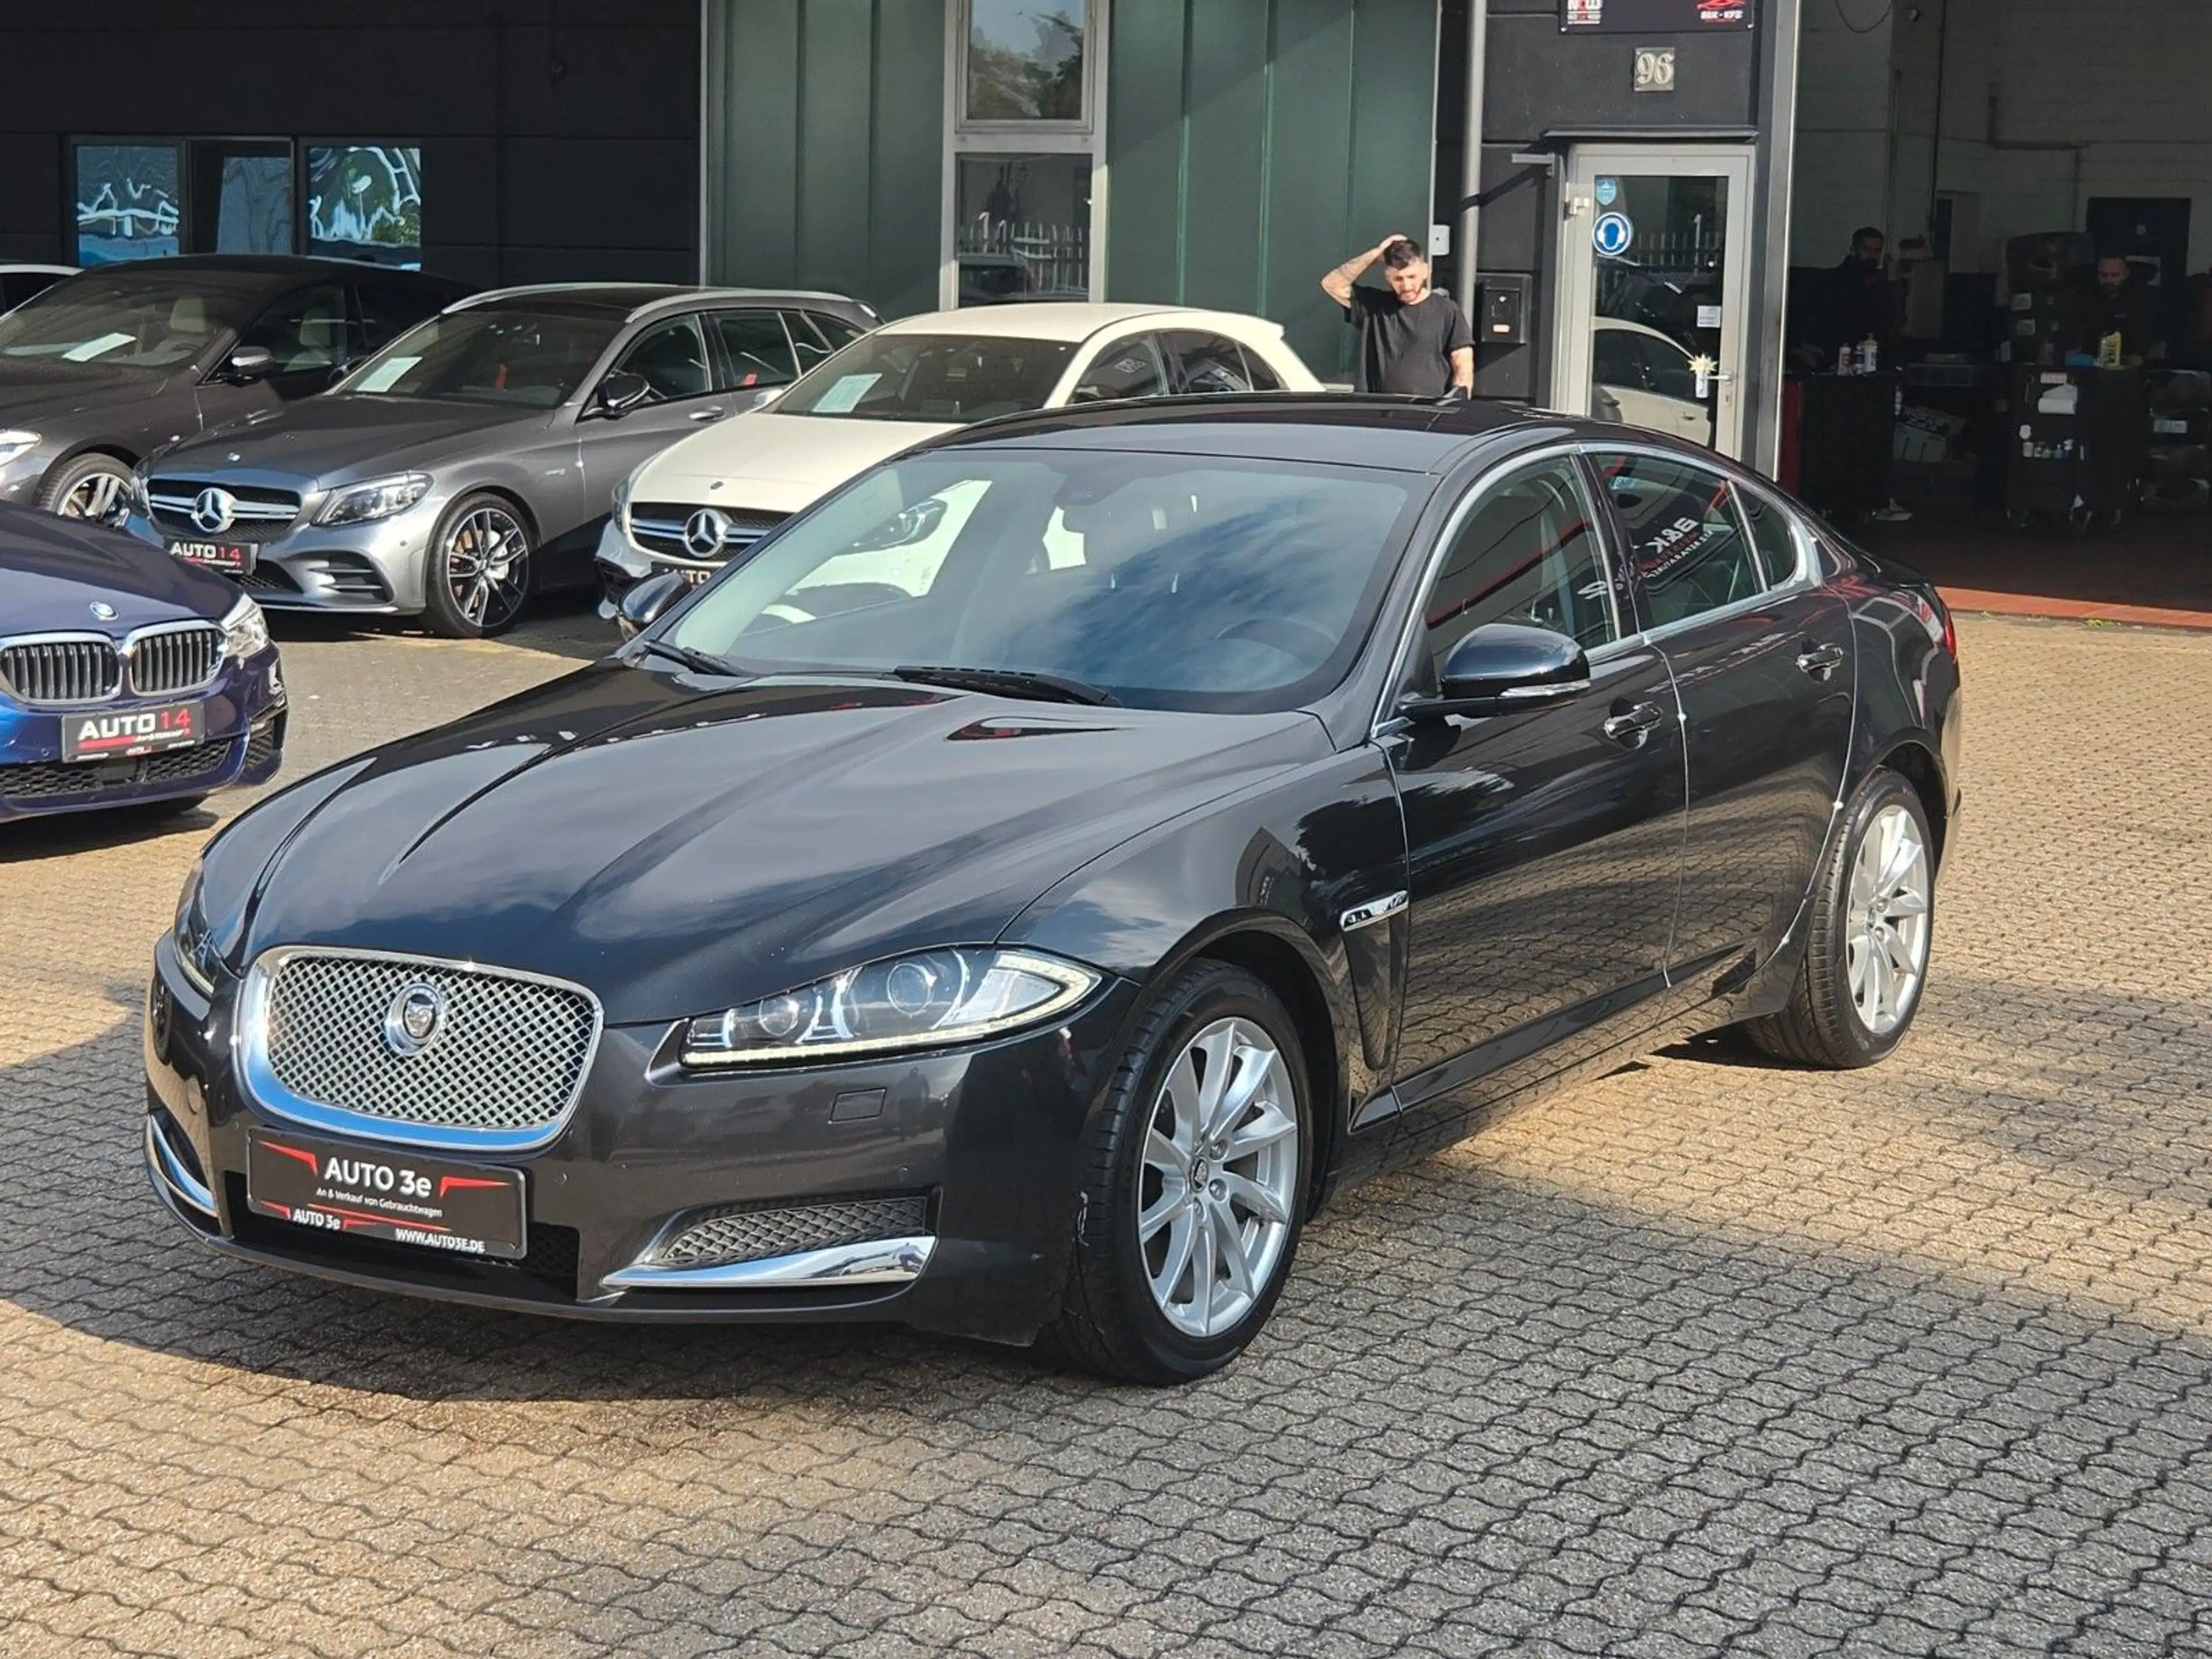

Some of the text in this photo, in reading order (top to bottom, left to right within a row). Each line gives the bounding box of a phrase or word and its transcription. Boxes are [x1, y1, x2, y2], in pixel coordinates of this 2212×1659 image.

[1637, 52, 1674, 84] 96
[170, 541, 240, 560] AUTO 14
[78, 712, 156, 741] AUTO
[160, 708, 191, 729] 14
[324, 1157, 432, 1198] AUTO 3e
[316, 1187, 443, 1218] An & Verkauf von Gebrauchtwagen
[293, 1208, 341, 1230] AUTO 3e
[393, 1228, 485, 1253] WWW.AUTO3E.DE
